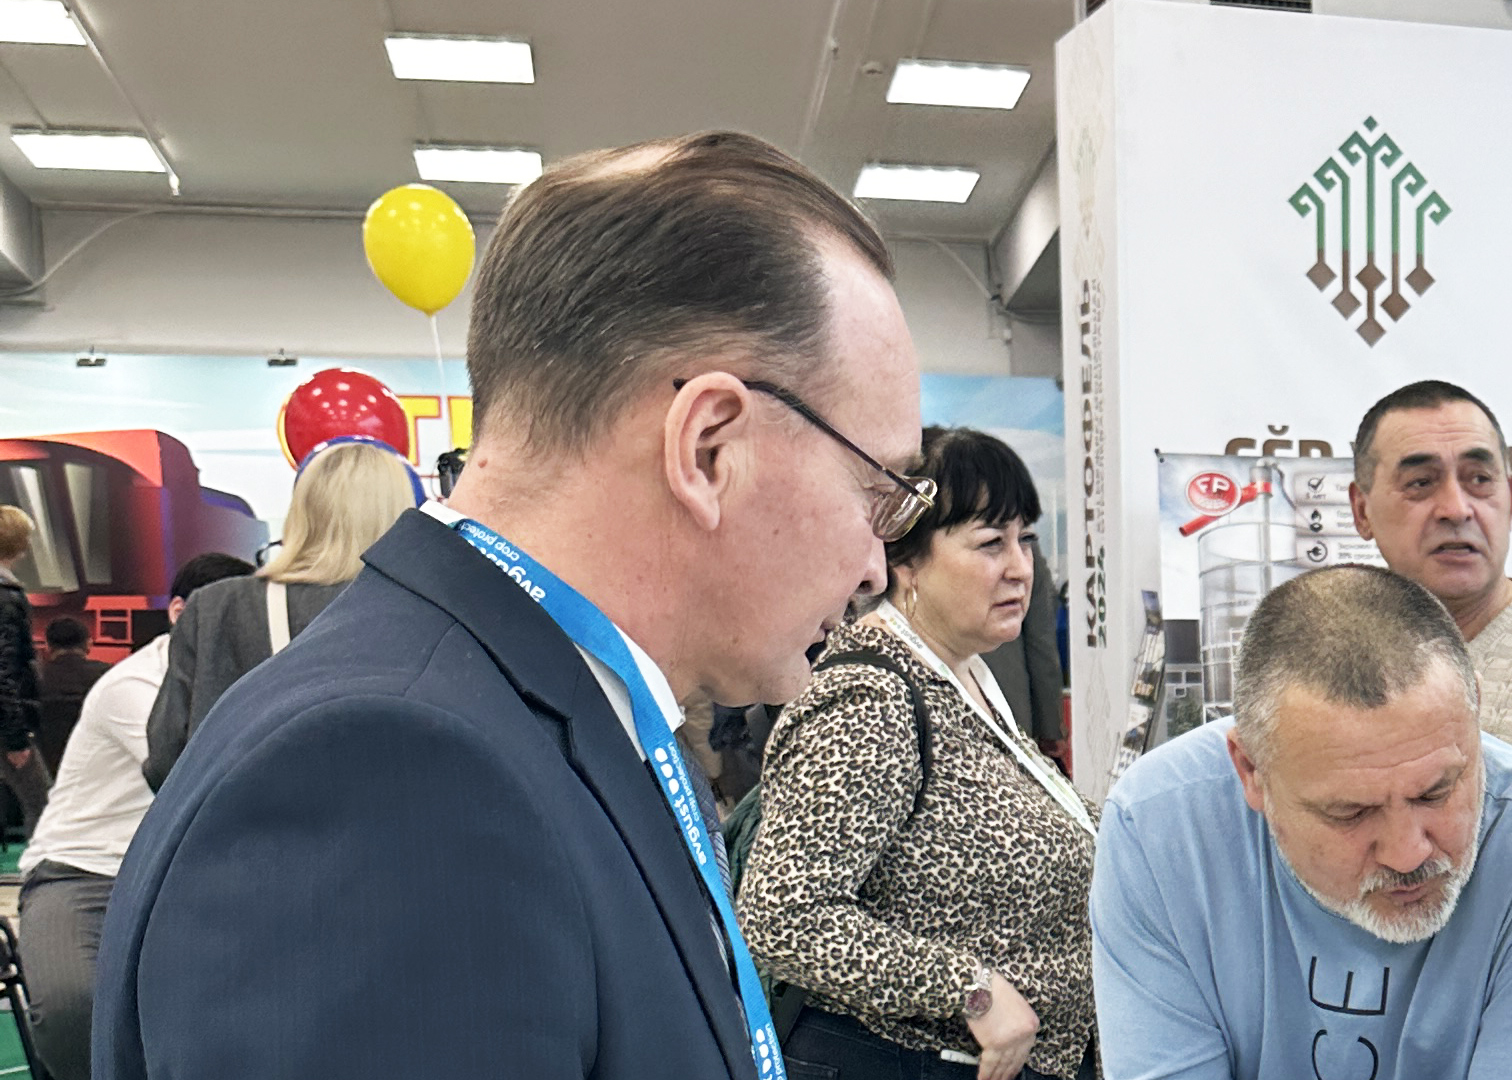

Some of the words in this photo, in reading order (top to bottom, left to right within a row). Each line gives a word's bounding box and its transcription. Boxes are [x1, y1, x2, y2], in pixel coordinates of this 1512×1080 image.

[1081, 280, 1097, 648] КАРТОФЕЛЬ
[495, 541, 520, 561] crop
[1097, 545, 1107, 649] 2024
[667, 741, 694, 798] protection
[674, 795, 707, 866] avgust
[765, 1023, 783, 1075] protection
